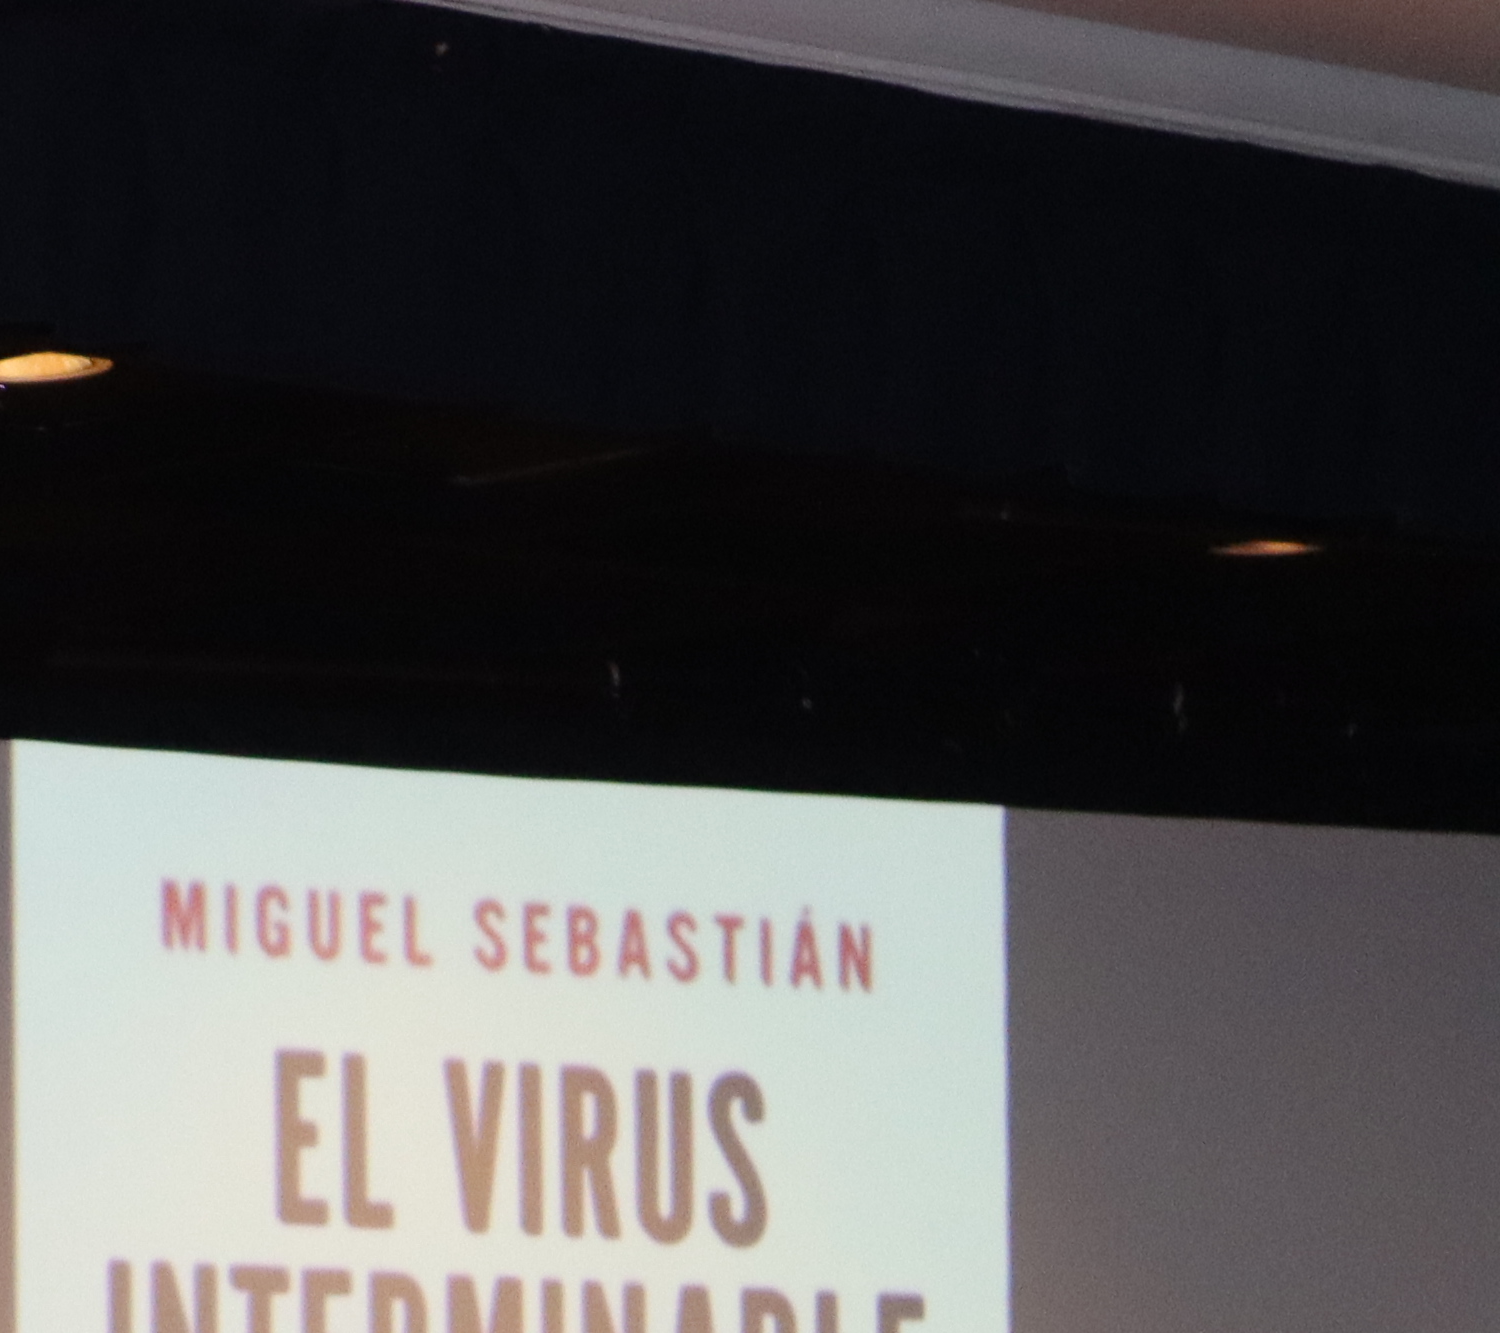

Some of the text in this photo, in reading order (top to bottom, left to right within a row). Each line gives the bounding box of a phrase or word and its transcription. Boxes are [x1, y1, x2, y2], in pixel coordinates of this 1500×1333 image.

[158, 877, 874, 994] MIGUEL SEBASTIÁN
[273, 1046, 769, 1249] EL VIRUS
